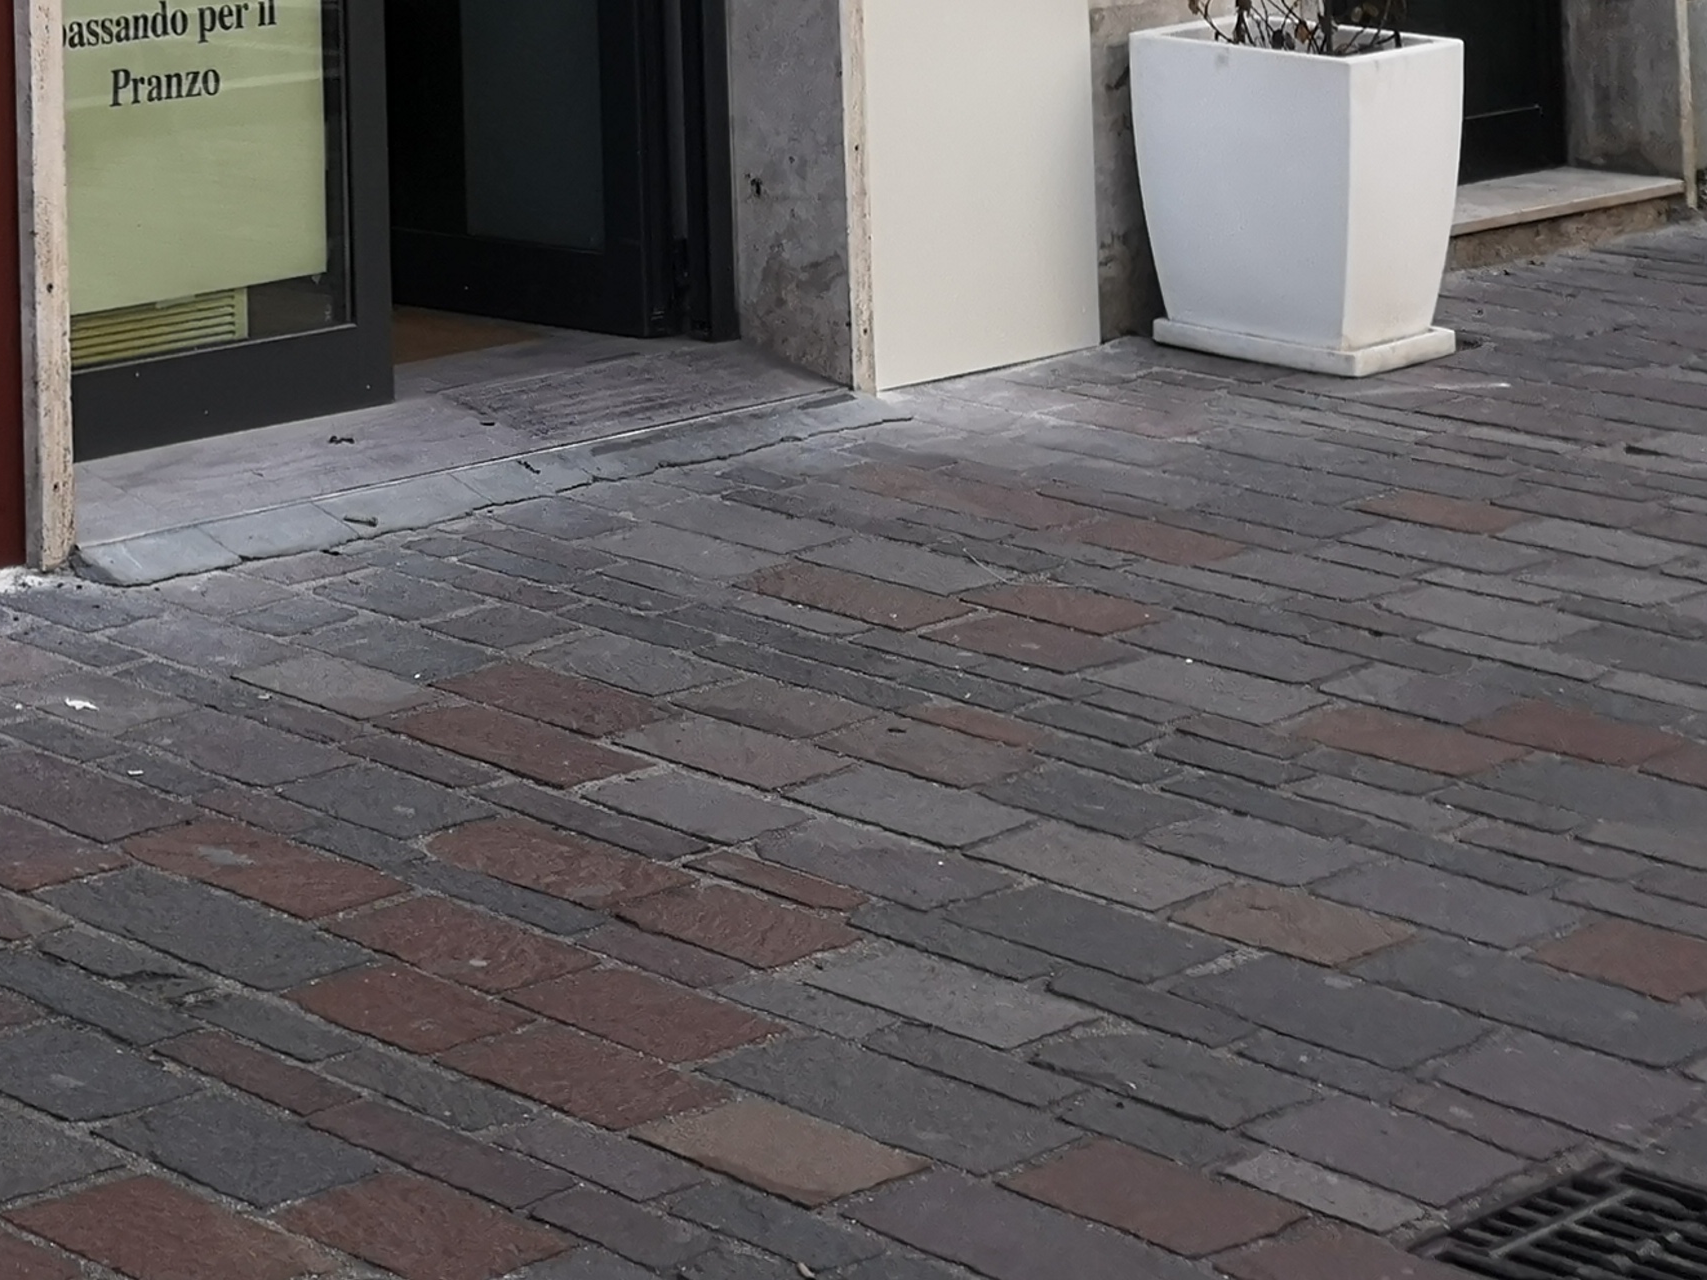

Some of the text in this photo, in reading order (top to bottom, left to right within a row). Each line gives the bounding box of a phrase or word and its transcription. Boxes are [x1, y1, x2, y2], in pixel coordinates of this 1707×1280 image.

[62, 1, 188, 49] assando
[198, 2, 248, 43] per
[110, 68, 220, 107] Pranzo
